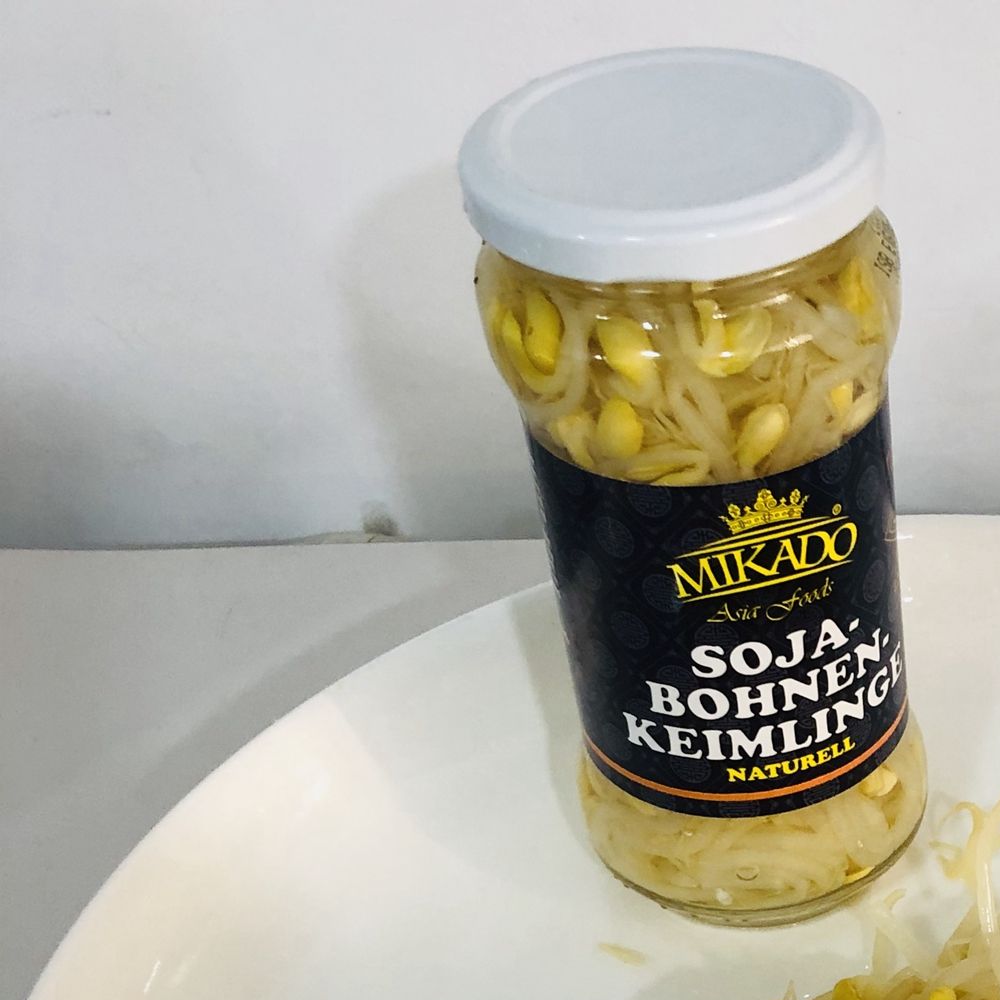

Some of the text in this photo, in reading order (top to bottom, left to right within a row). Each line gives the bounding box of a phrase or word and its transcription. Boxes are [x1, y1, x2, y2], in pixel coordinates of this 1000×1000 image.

[666, 522, 858, 598] MIKADO
[706, 576, 835, 622] Asia Foods
[646, 627, 890, 720] BOHNEN-
[691, 618, 860, 678] SOJA-
[623, 641, 903, 761] KEIMLINGE
[726, 737, 856, 782] NATURELL
